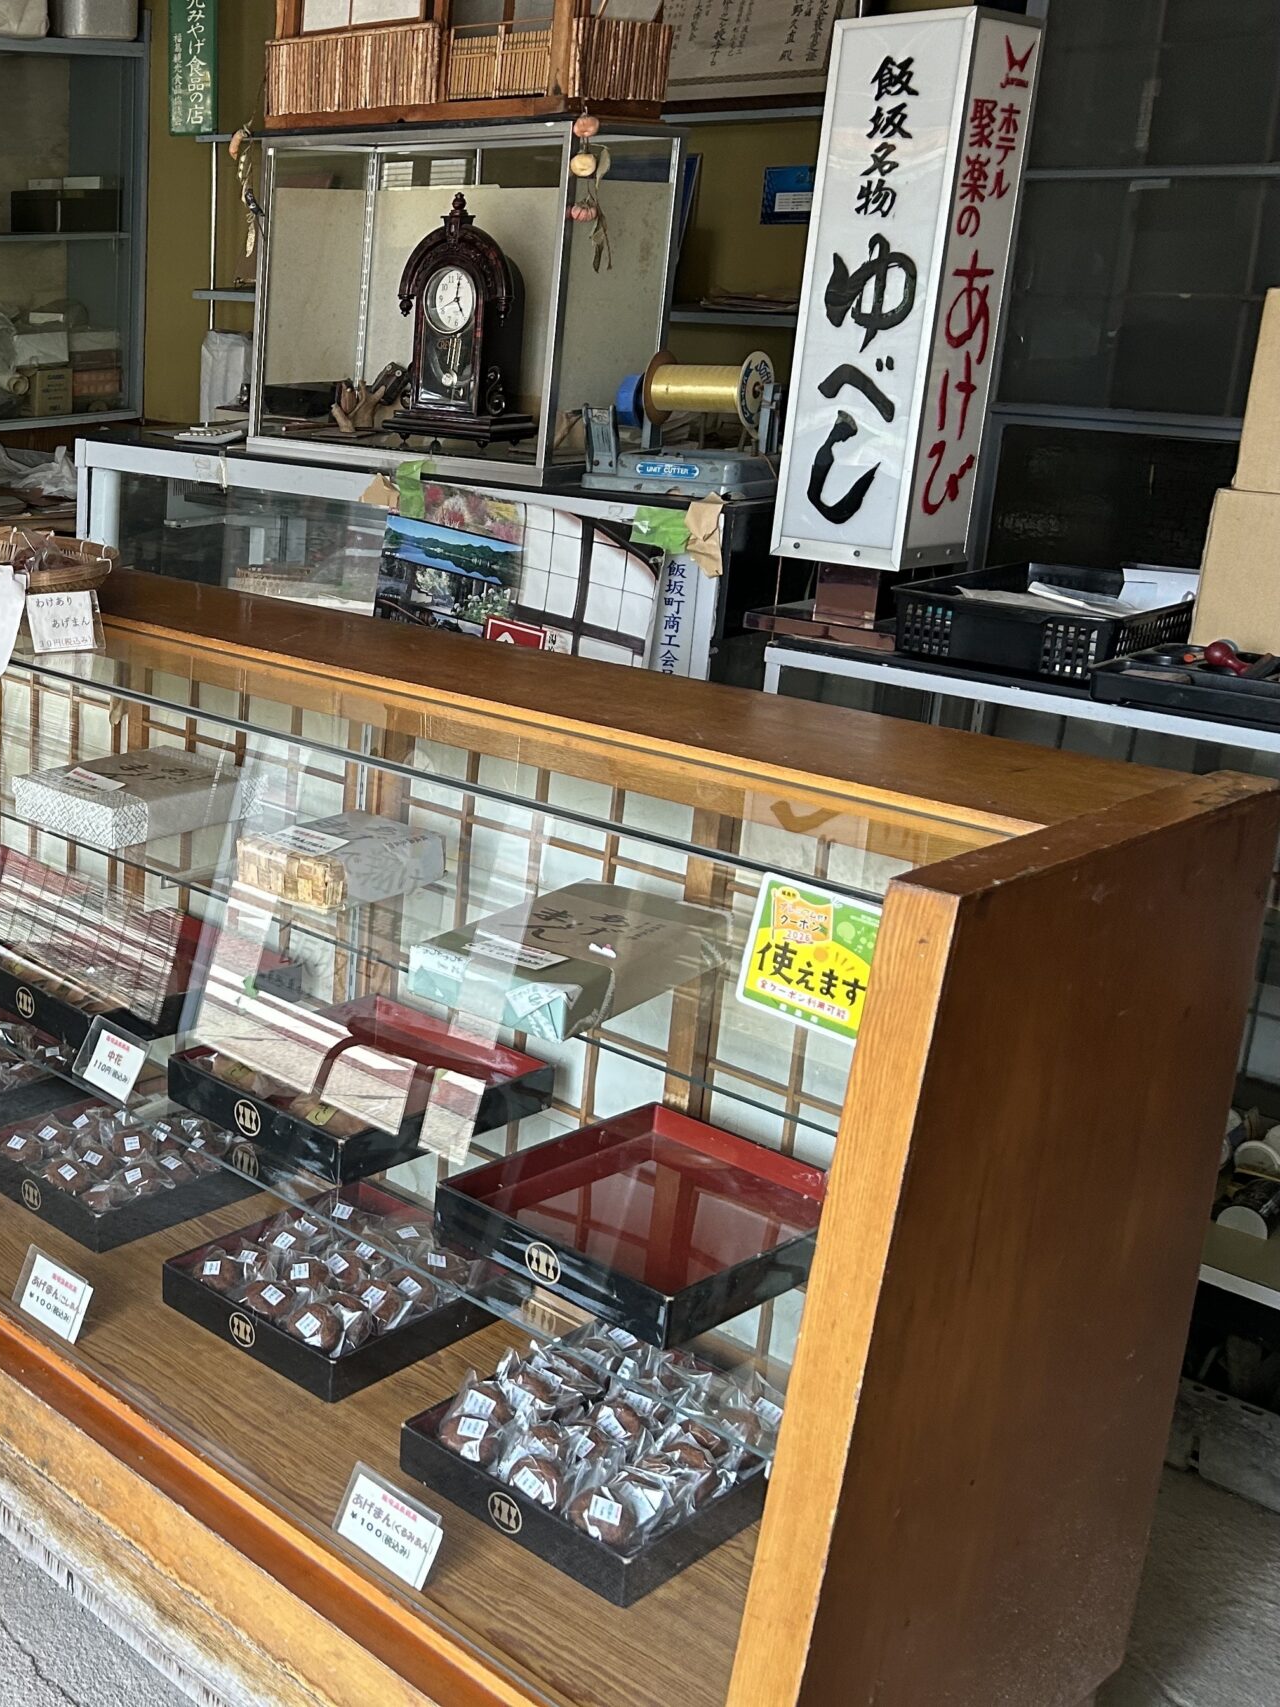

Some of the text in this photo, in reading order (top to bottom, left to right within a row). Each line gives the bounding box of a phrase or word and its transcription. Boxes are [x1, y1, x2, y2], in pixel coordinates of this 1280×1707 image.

[854, 55, 919, 218] 飯坂名物
[956, 98, 998, 238] 聚楽の
[988, 102, 1021, 199] ホテル
[807, 232, 918, 524] ゆべし
[922, 249, 994, 515] あけび
[646, 466, 689, 475] UNIT CUTTER
[35, 596, 73, 608] わけあり
[51, 615, 91, 629] あげまん
[756, 941, 867, 1007] 使えます
